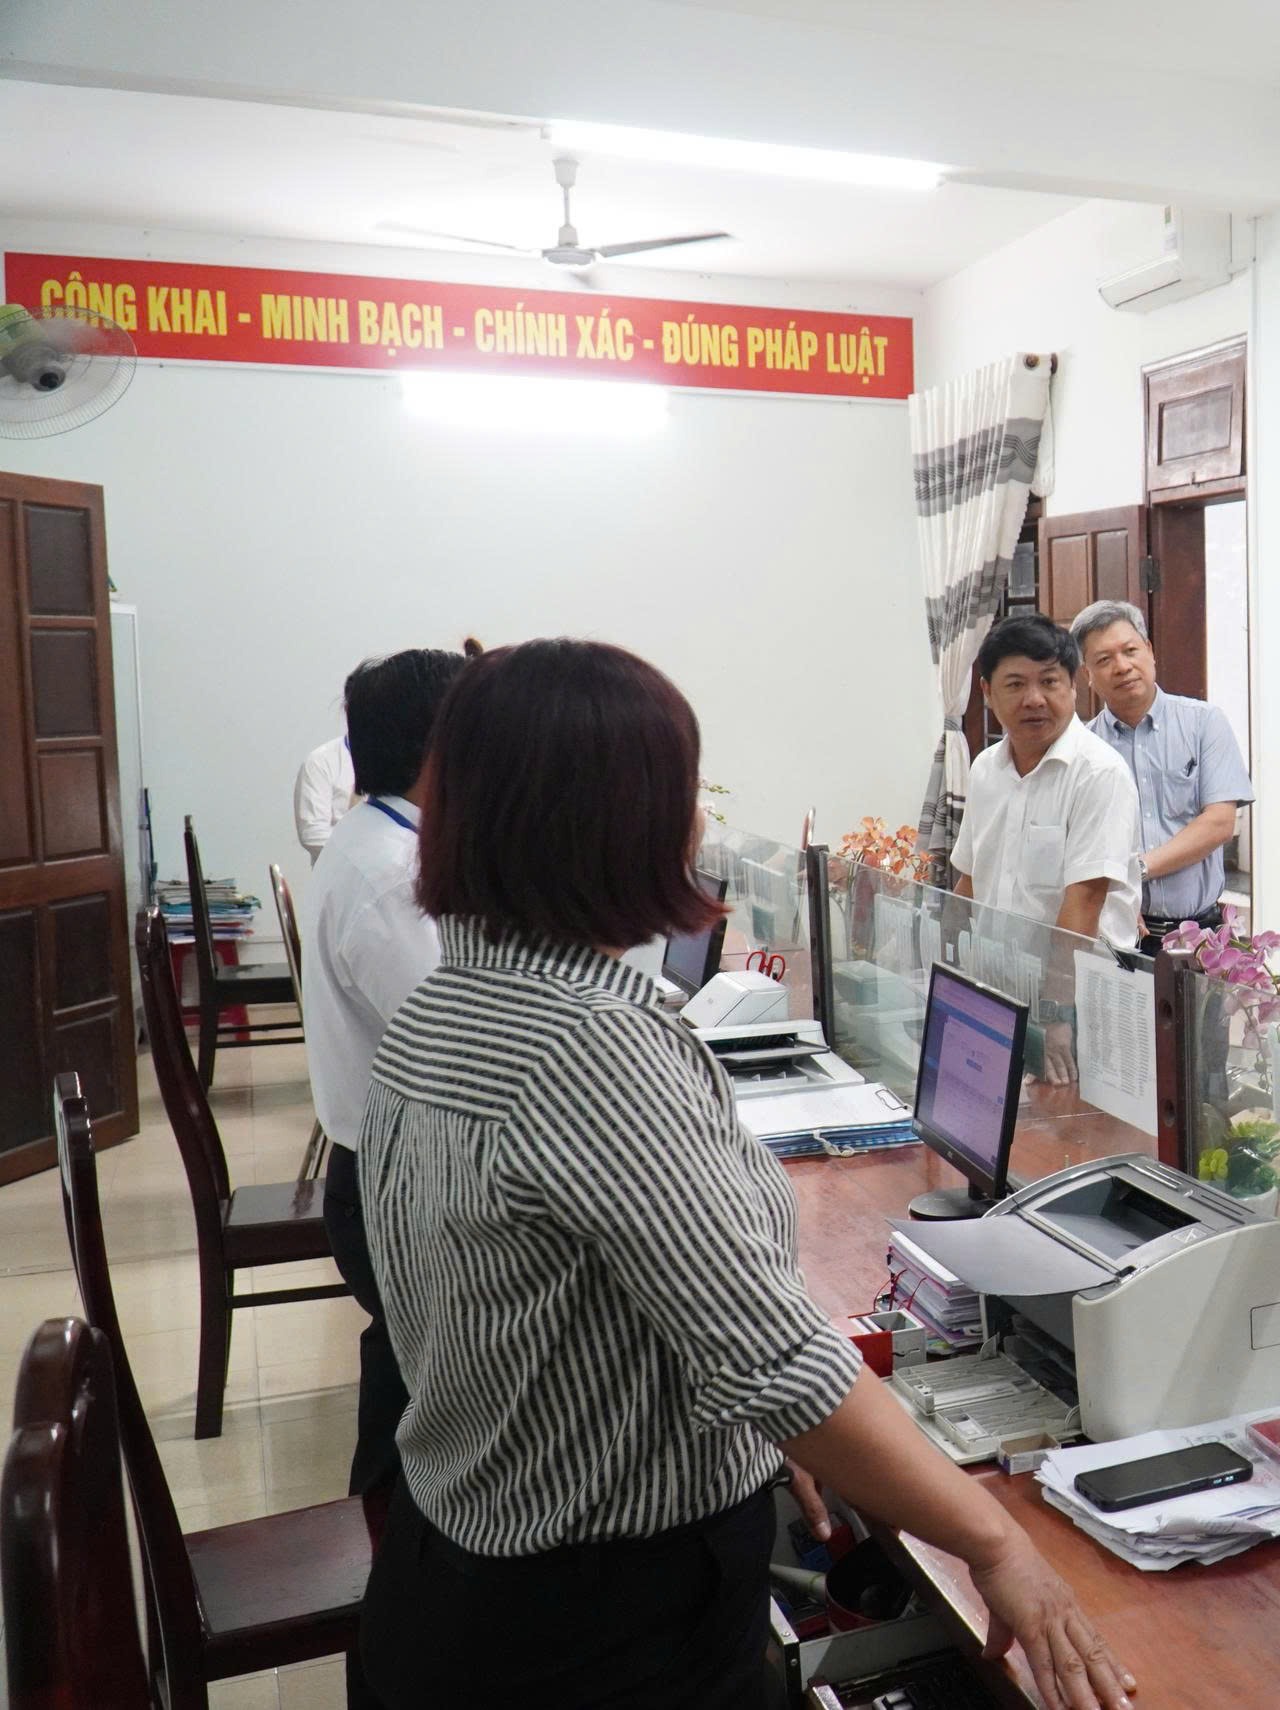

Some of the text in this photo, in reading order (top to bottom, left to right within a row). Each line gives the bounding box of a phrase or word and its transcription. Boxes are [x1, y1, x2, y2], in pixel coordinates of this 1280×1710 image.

[40, 271, 137, 331] CÔNG
[147, 285, 228, 336] KHAI
[261, 293, 350, 344] MINH
[358, 300, 444, 356] BẠCH
[474, 302, 568, 358] CHÍNH
[575, 309, 634, 361] XÁC
[661, 314, 739, 368] ĐÚNG
[747, 321, 818, 372] PHÁP
[825, 327, 889, 384] LUẬT
